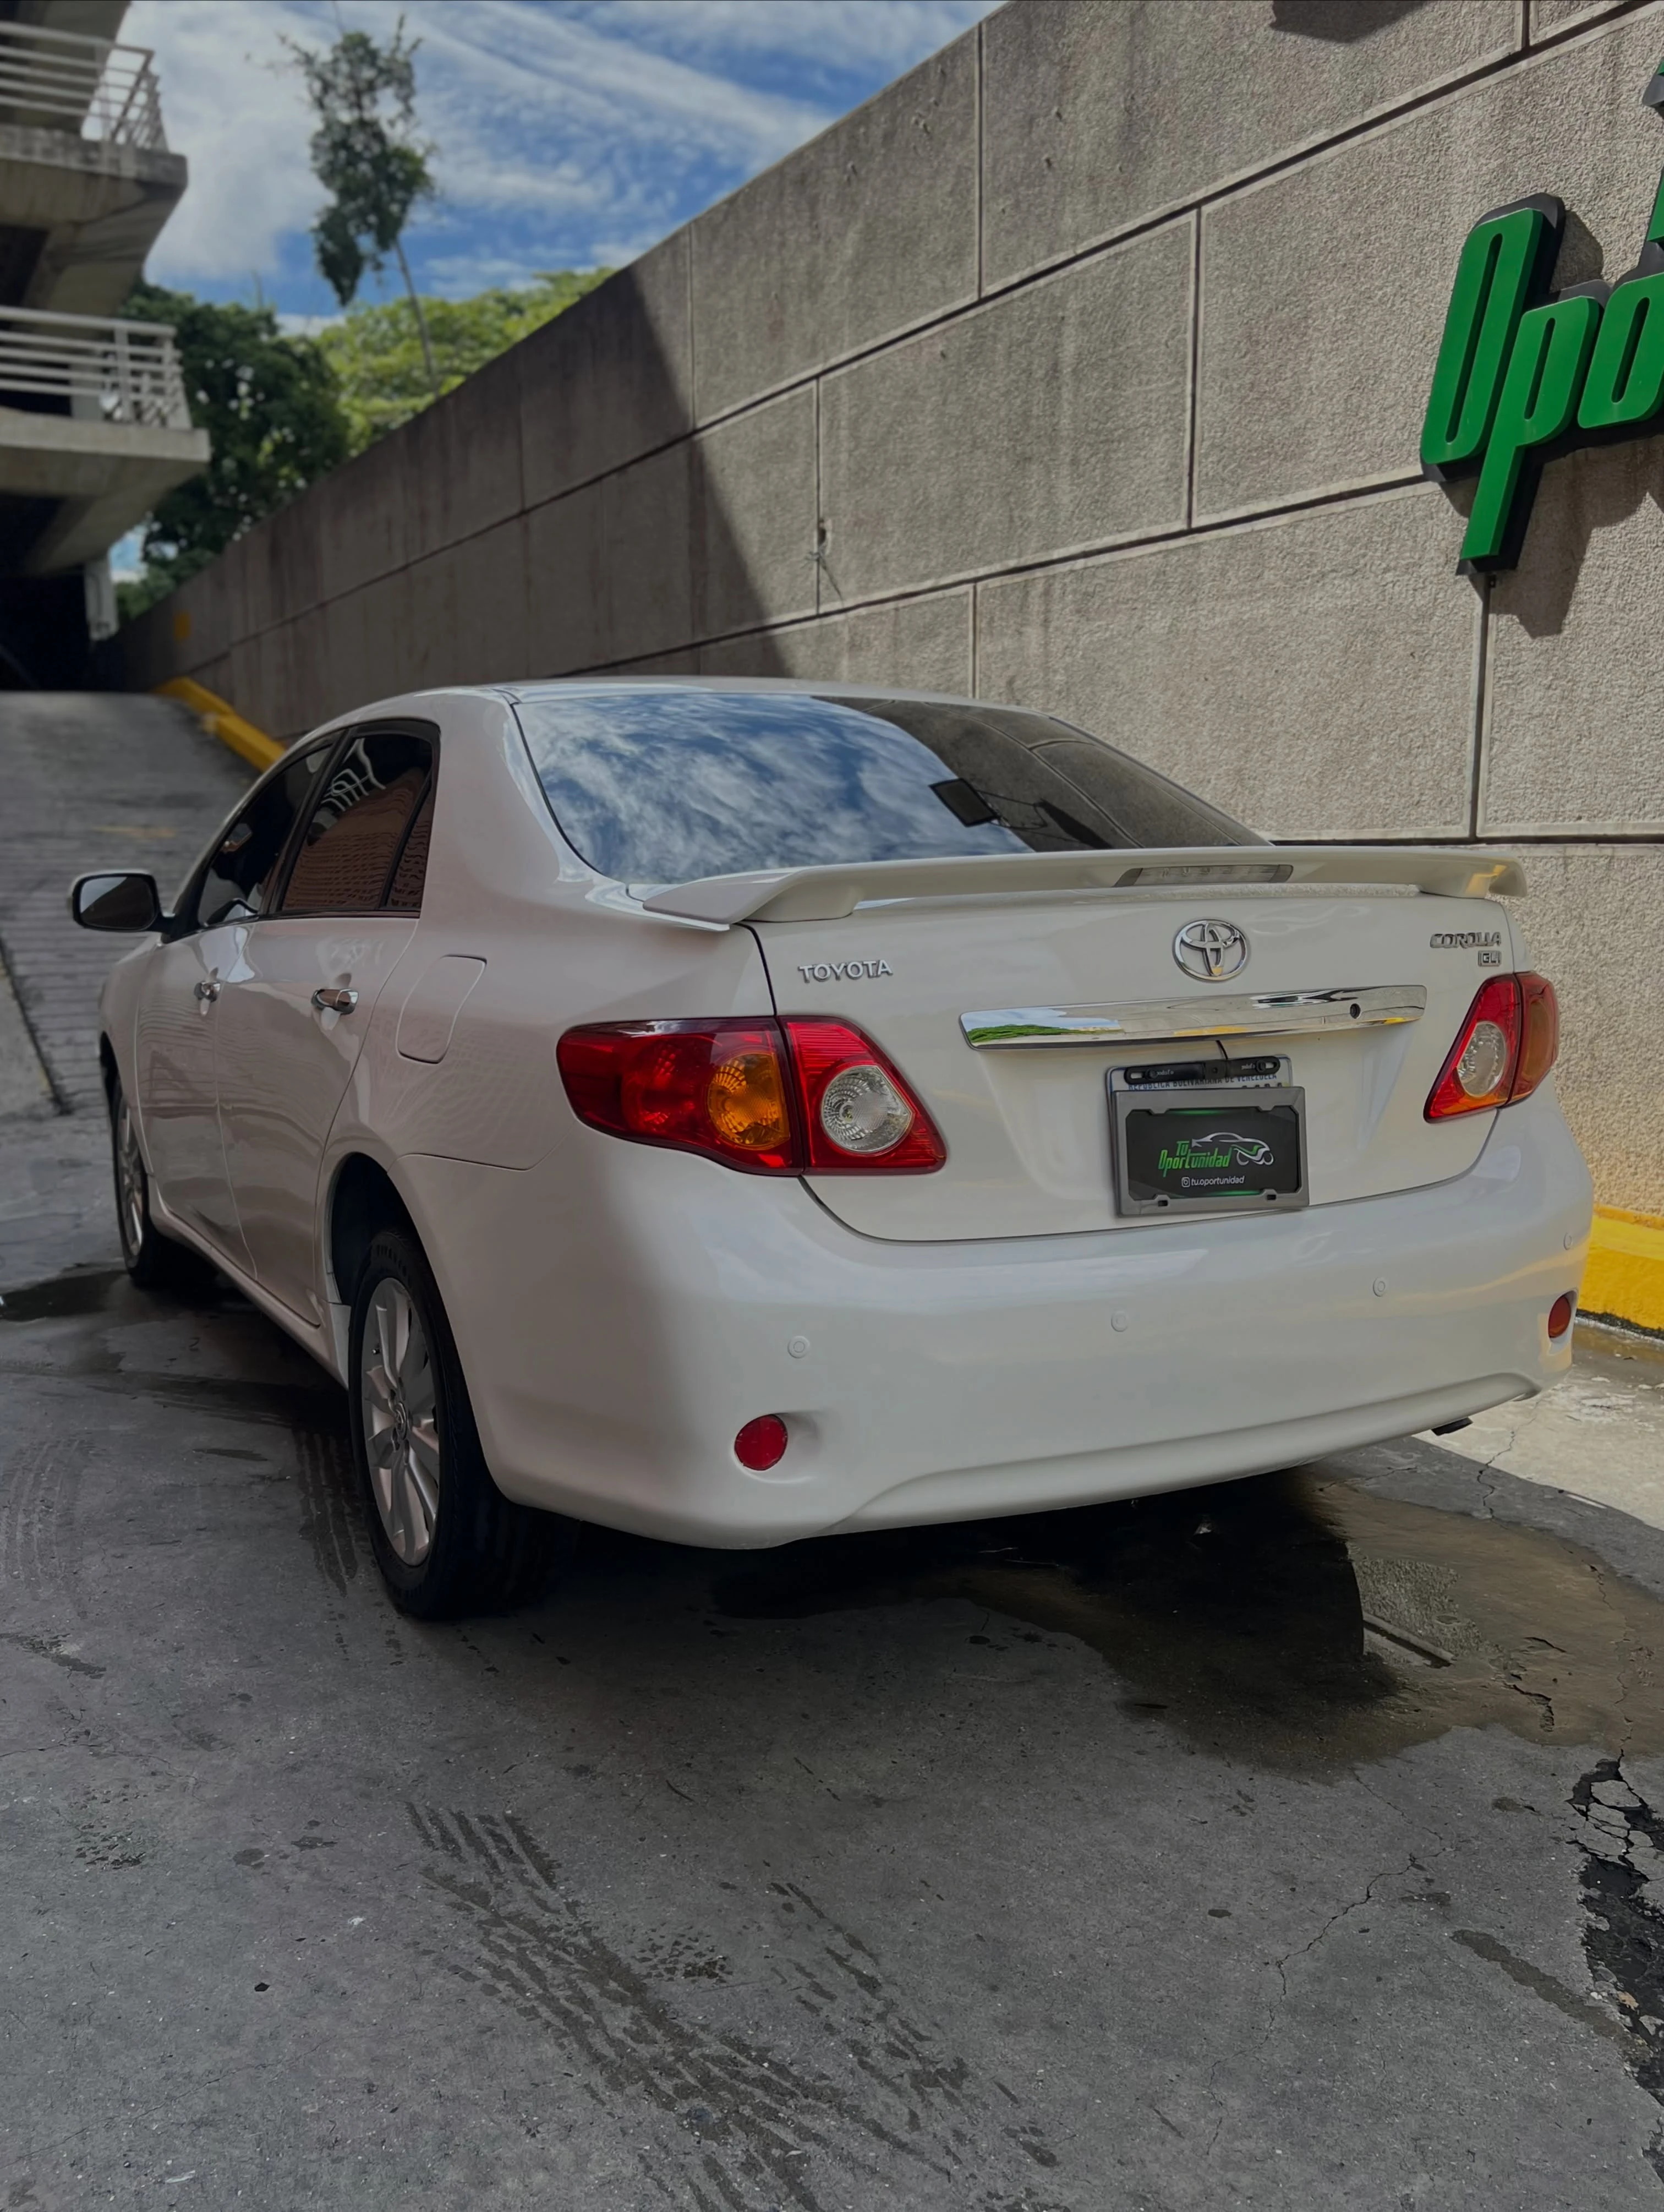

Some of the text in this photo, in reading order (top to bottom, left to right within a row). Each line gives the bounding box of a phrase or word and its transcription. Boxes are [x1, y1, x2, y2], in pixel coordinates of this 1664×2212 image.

[1430, 932, 1502, 948] COROLLA
[798, 959, 893, 983] TOYOTA
[1158, 1146, 1233, 1177] Oportunidad
